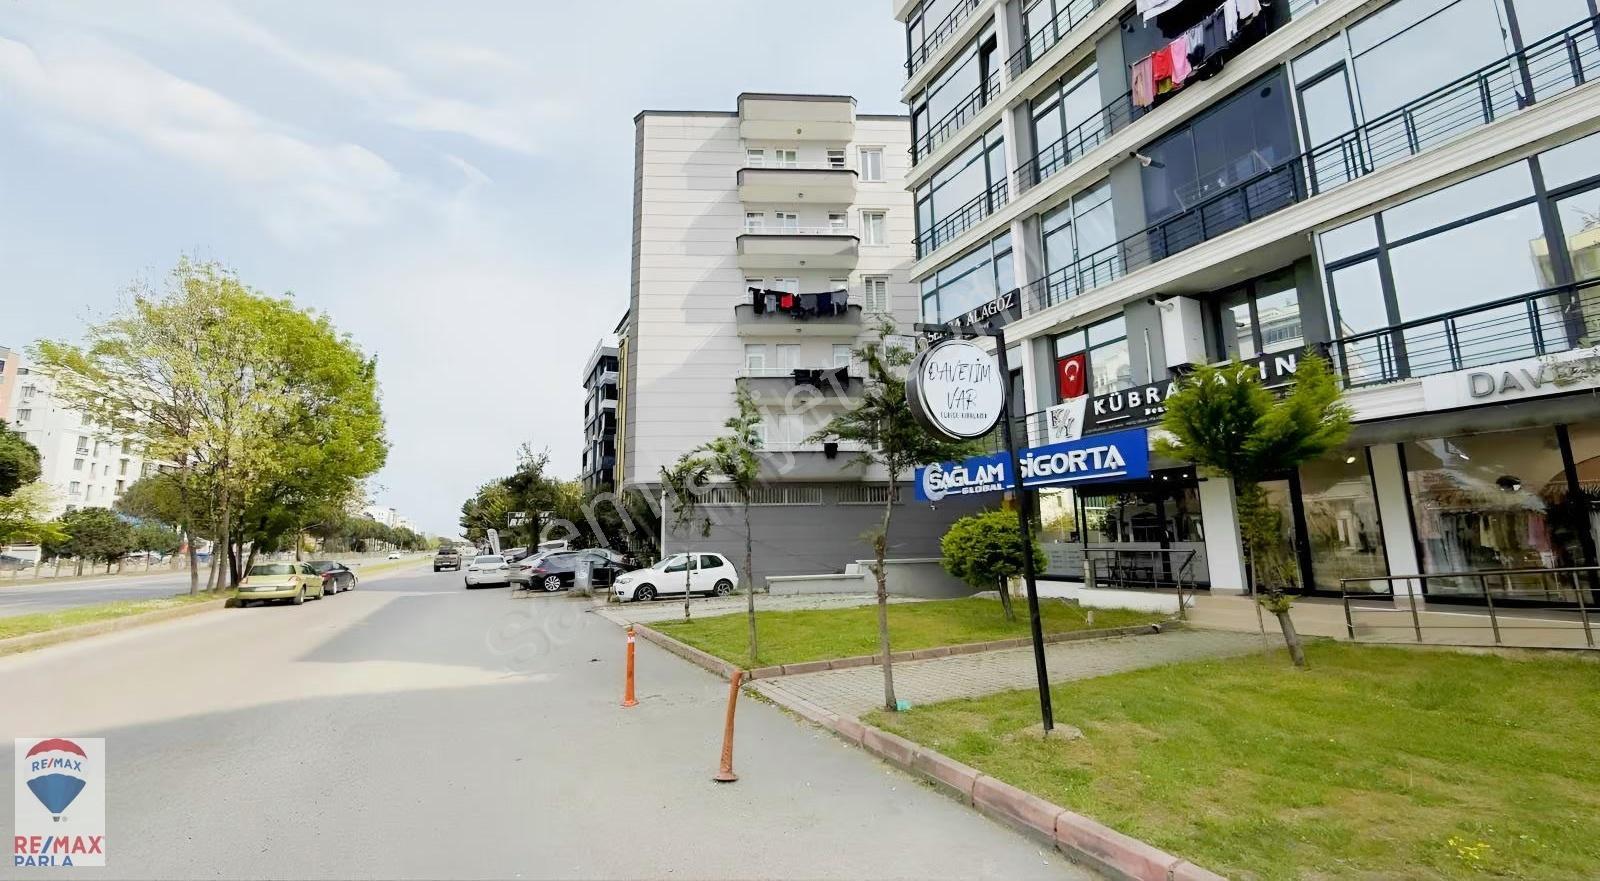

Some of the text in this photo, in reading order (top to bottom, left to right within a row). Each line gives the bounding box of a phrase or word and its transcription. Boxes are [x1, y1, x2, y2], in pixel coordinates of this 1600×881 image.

[1467, 364, 1546, 398] DAV
[947, 387, 977, 411] VAR
[1093, 382, 1180, 416] KÜBRA
[928, 462, 1004, 490] SAĞLAM
[961, 483, 1004, 496] GLOBAL
